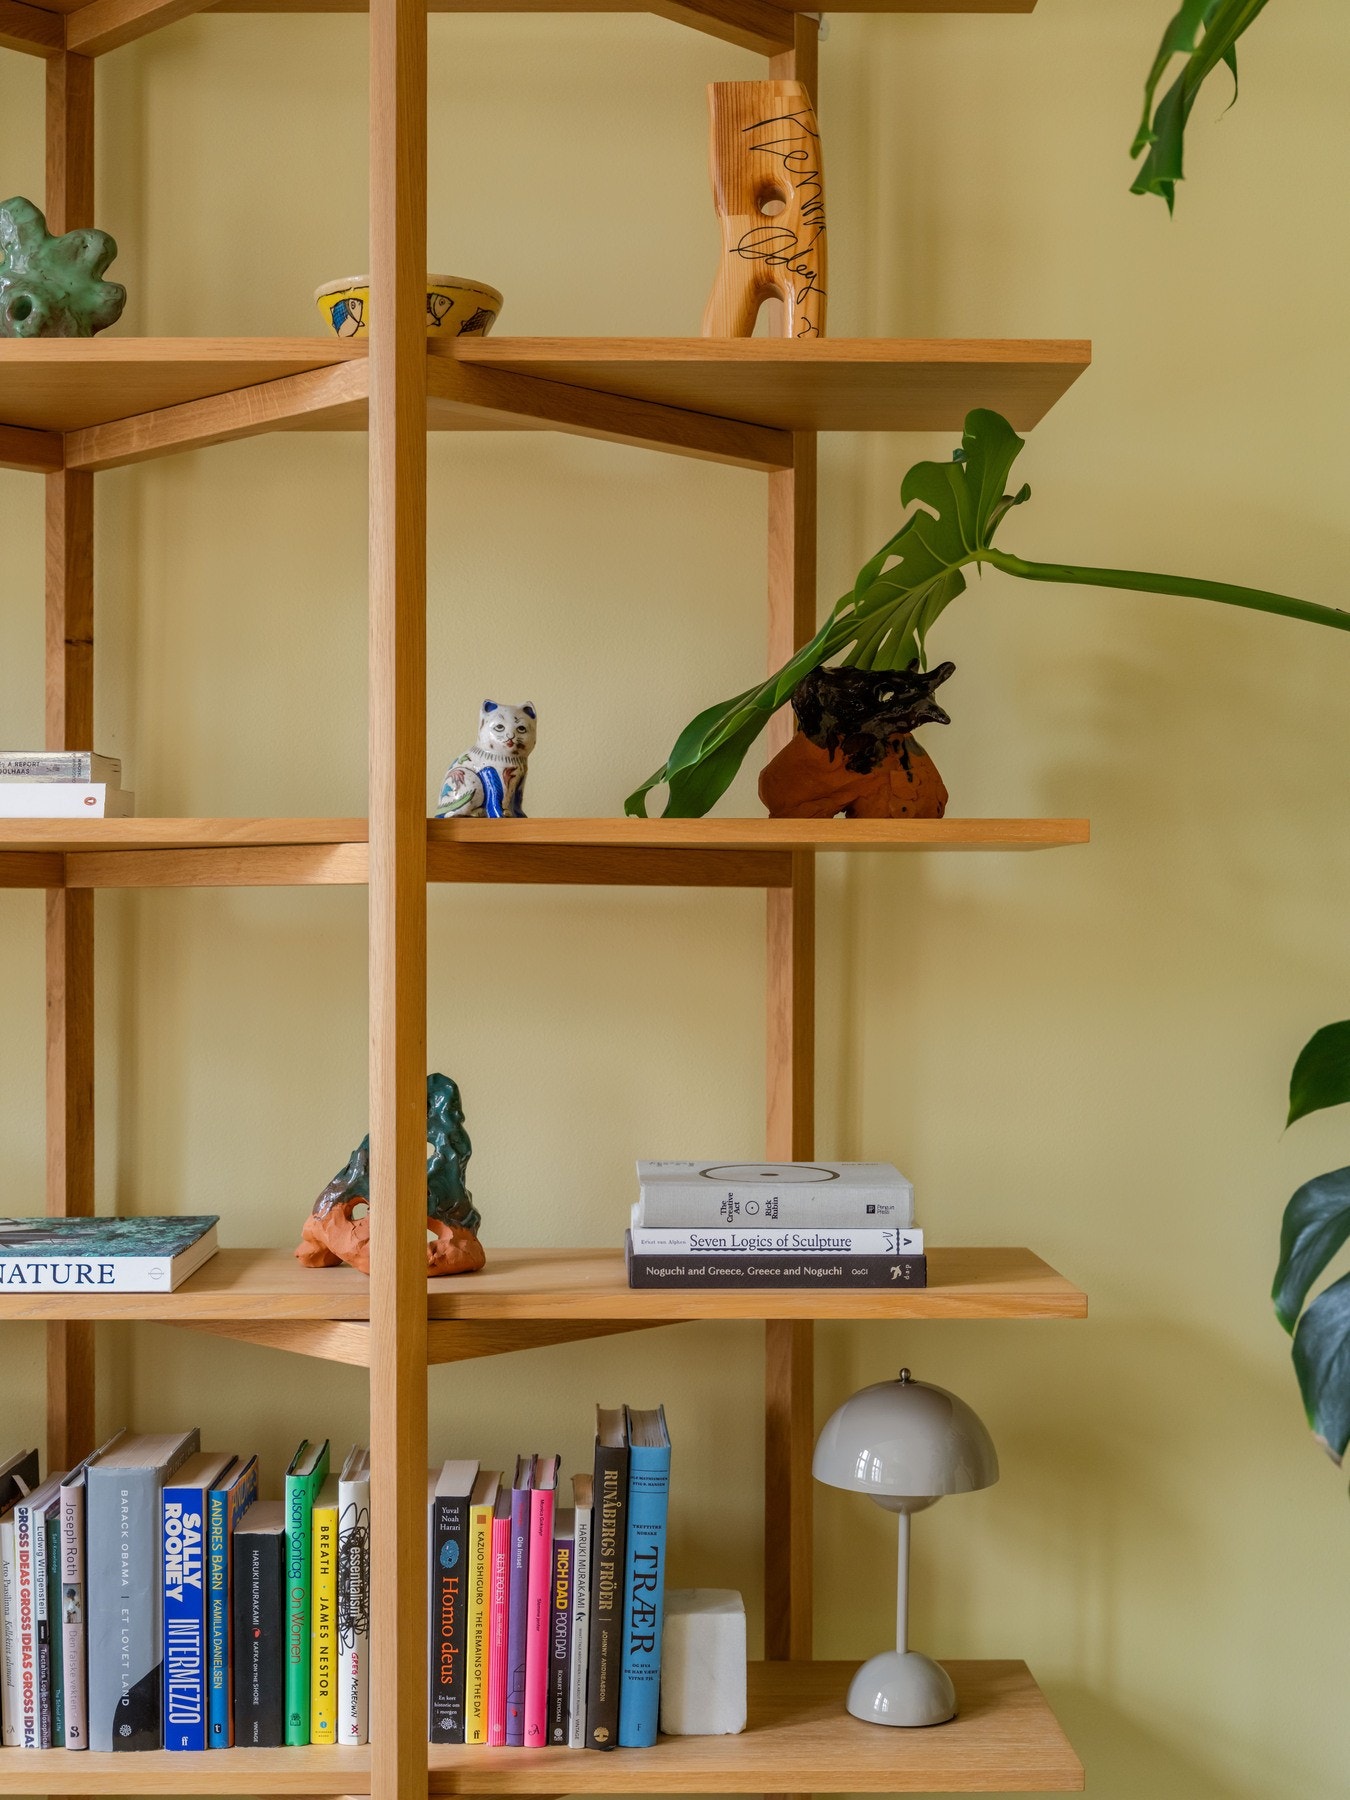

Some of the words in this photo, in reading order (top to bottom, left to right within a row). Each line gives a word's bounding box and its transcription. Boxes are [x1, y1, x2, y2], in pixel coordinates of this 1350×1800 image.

[690, 1234, 726, 1247] Seven
[731, 1234, 772, 1250] Logics
[776, 1234, 789, 1247] of
[793, 1234, 852, 1249] Sculpture
[0, 1264, 116, 1284] ATURE
[646, 1267, 685, 1277] Noguchi
[688, 1267, 705, 1276] and
[708, 1267, 744, 1277] Greece,
[747, 1267, 781, 1276] Greece
[784, 1267, 800, 1276] and
[804, 1267, 843, 1277] Noguchi
[19, 1508, 29, 1547] GROSS
[65, 1503, 77, 1544] Joseph
[211, 1499, 222, 1551] ANDRES
[292, 1489, 305, 1529] Susan
[601, 1470, 621, 1556] RUNÅBERGS
[37, 1526, 45, 1556] Ludwig
[165, 1503, 182, 1602] ROONEY
[183, 1513, 201, 1589] SALLY
[288, 1531, 305, 1579] Sontag
[320, 1526, 329, 1575] BREATH
[477, 1531, 485, 1560] KAZUO
[579, 1524, 587, 1557] HARUKI
[20, 1550, 30, 1586] IDEAS
[67, 1548, 77, 1576] Roth
[212, 1555, 222, 1591] BARN
[252, 1550, 260, 1580] HARUKI
[496, 1553, 505, 1572] REN
[557, 1549, 569, 1578] RICH
[3, 1579, 11, 1615] Paasilinna
[38, 1559, 46, 1615] Wittgenstein
[291, 1587, 305, 1609] On
[350, 1547, 363, 1617] essentialism
[476, 1563, 484, 1605] ISHIGURO
[496, 1575, 504, 1604] POESI
[556, 1581, 568, 1609] DAD
[577, 1560, 586, 1608] MURAKAMI
[599, 1562, 617, 1610] FRÖER
[630, 1546, 658, 1655] TRÆR
[21, 1589, 31, 1630] GROSS
[122, 1609, 129, 1624] ET
[213, 1600, 222, 1637] KAMILLA
[320, 1597, 329, 1639] JAMES
[442, 1577, 459, 1637] Homo
[556, 1612, 568, 1637] POOR
[22, 1633, 32, 1669] IDEAS
[69, 1631, 77, 1648] Den
[291, 1611, 304, 1664] Women
[475, 1630, 483, 1667] REMAINS
[555, 1639, 566, 1659] DAD
[70, 1651, 78, 1678] falske
[168, 1619, 200, 1723] INTERMEZZO
[214, 1639, 222, 1688] DANIELSEN
[320, 1646, 329, 1697] NESTOR
[441, 1642, 459, 1684] deus
[475, 1670, 482, 1681] OF
[23, 1671, 33, 1713] GROSS
[70, 1680, 78, 1709] vekten
[41, 1681, 49, 1748] Logico-Philosophicus
